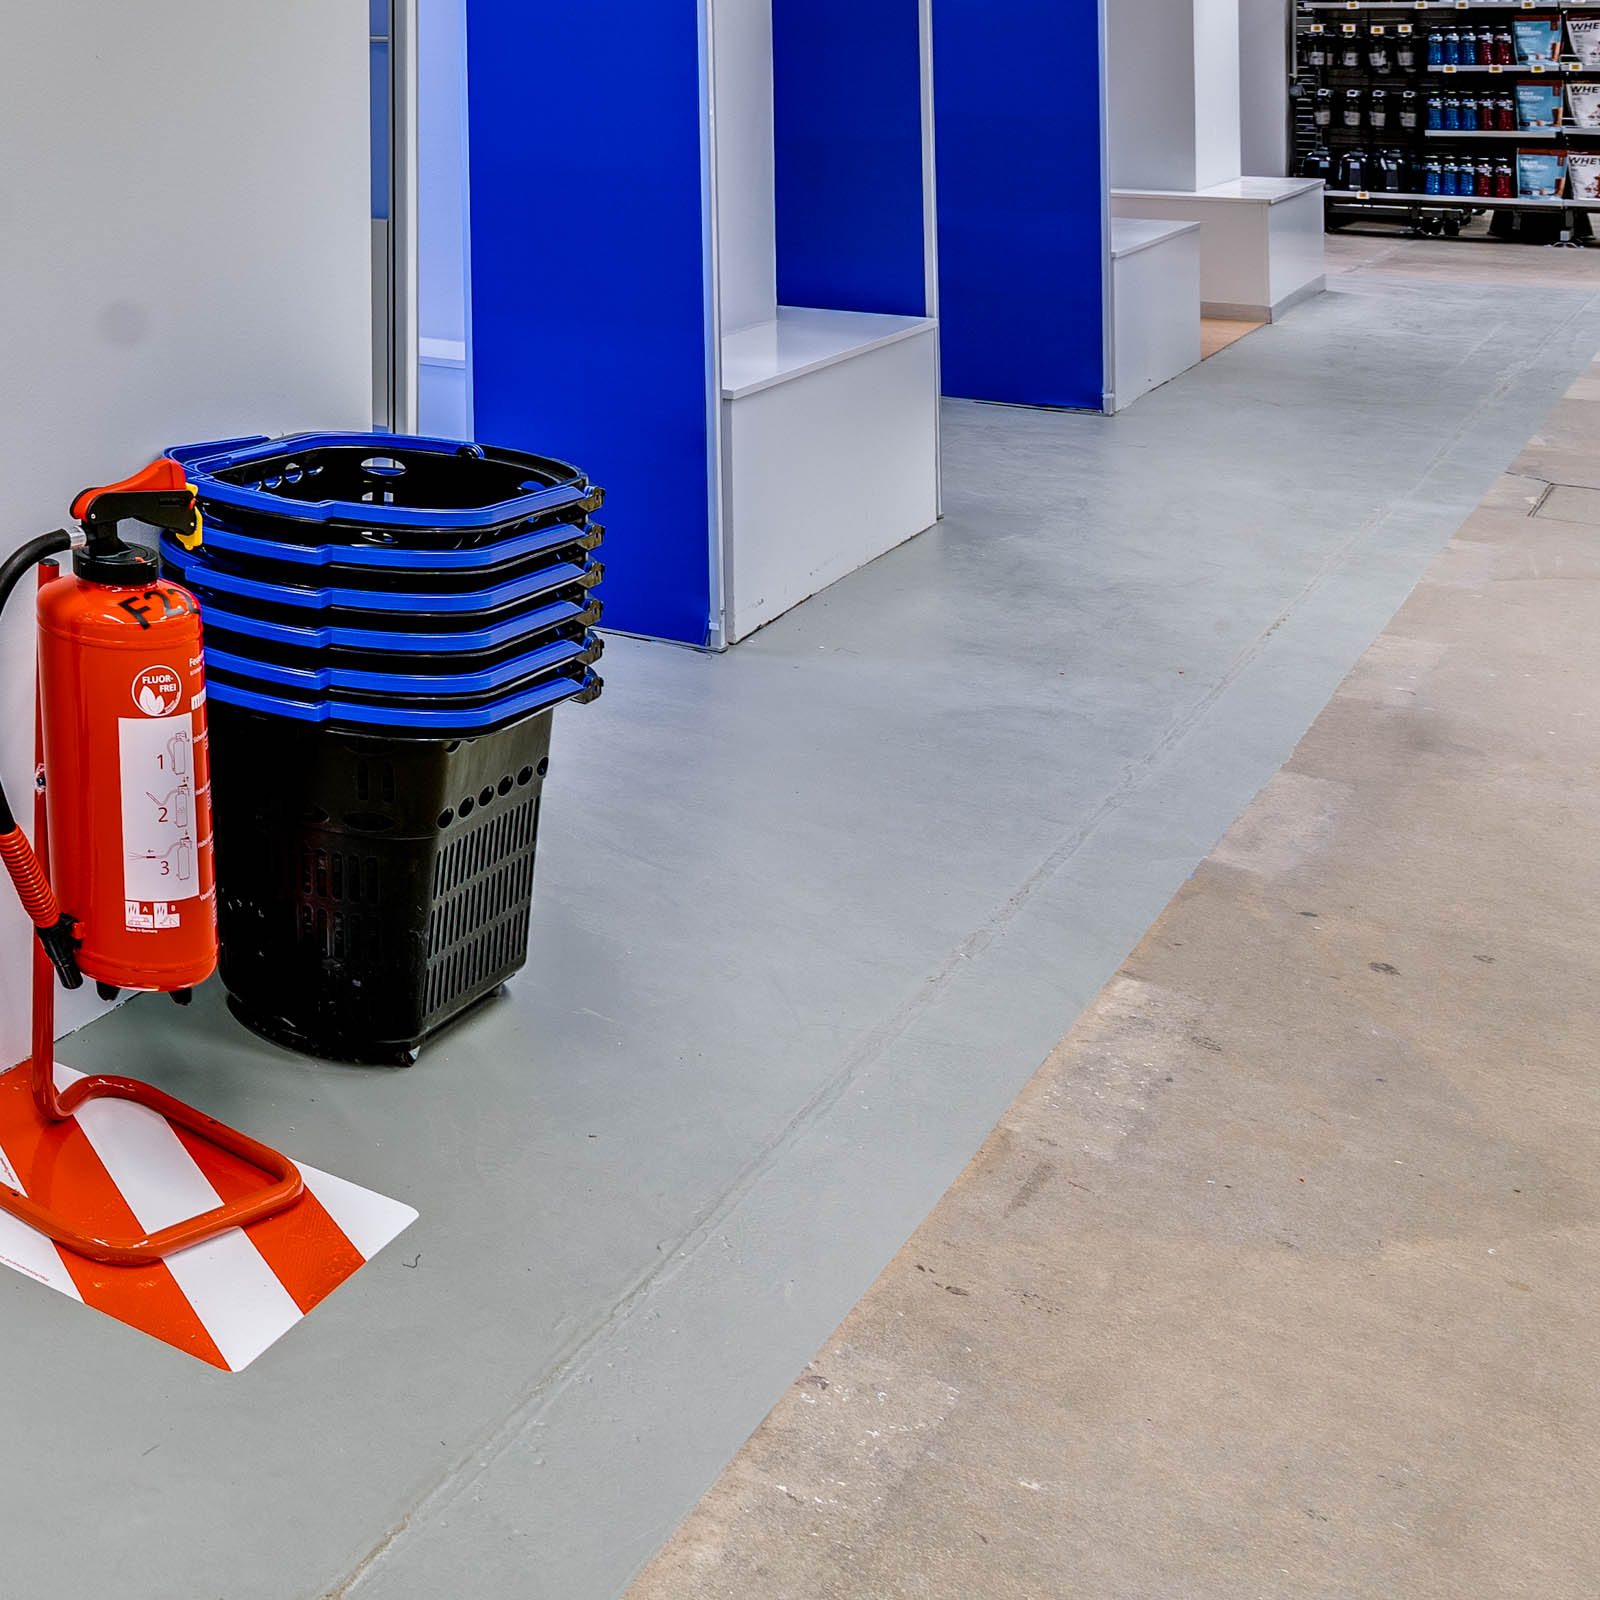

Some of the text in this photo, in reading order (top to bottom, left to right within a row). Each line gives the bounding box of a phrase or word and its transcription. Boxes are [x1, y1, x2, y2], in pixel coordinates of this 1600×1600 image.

[142, 674, 174, 685] FLUOR-
[159, 683, 177, 693] FREI
[156, 754, 164, 770] 1
[158, 807, 168, 823] 2
[160, 861, 169, 876] 3
